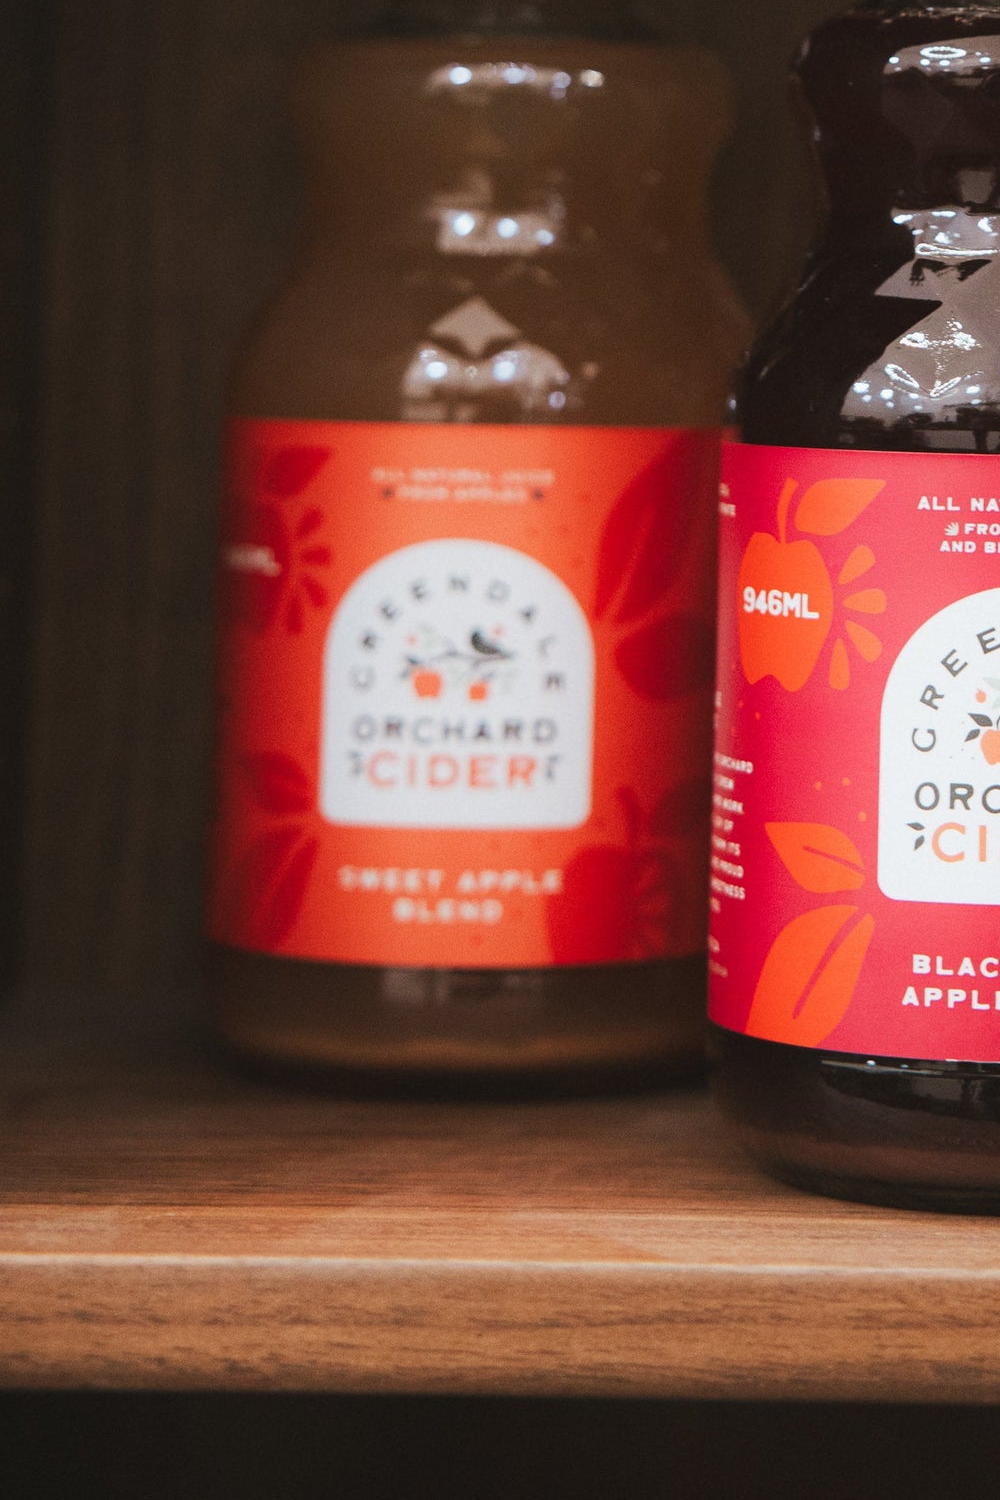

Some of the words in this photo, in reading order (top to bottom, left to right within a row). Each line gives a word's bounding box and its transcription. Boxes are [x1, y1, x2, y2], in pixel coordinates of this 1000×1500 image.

[917, 496, 961, 512] ALL
[939, 540, 977, 554] AND
[742, 585, 820, 620] 946ML
[352, 715, 559, 746] ORCHARD
[366, 750, 540, 790] CIDER
[456, 868, 562, 896] APPLE
